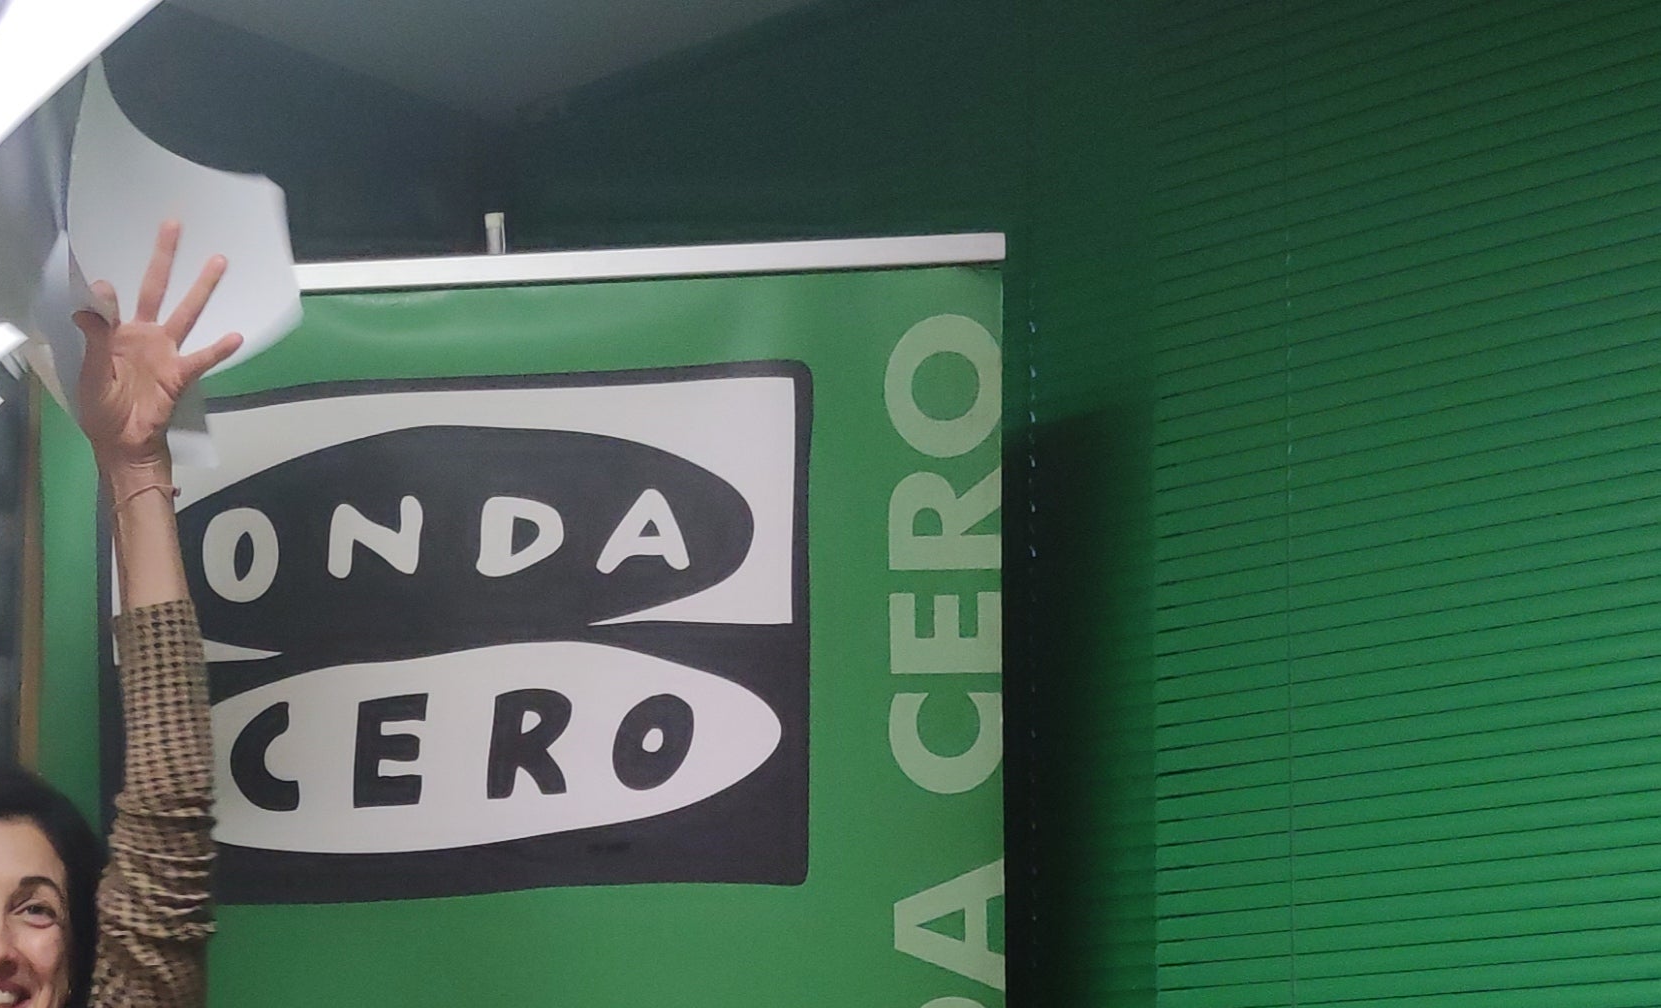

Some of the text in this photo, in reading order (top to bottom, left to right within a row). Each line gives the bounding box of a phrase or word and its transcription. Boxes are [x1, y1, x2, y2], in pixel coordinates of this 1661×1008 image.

[202, 488, 690, 602] ONDA
[884, 314, 1003, 794] CERO
[230, 688, 694, 812] CERO
